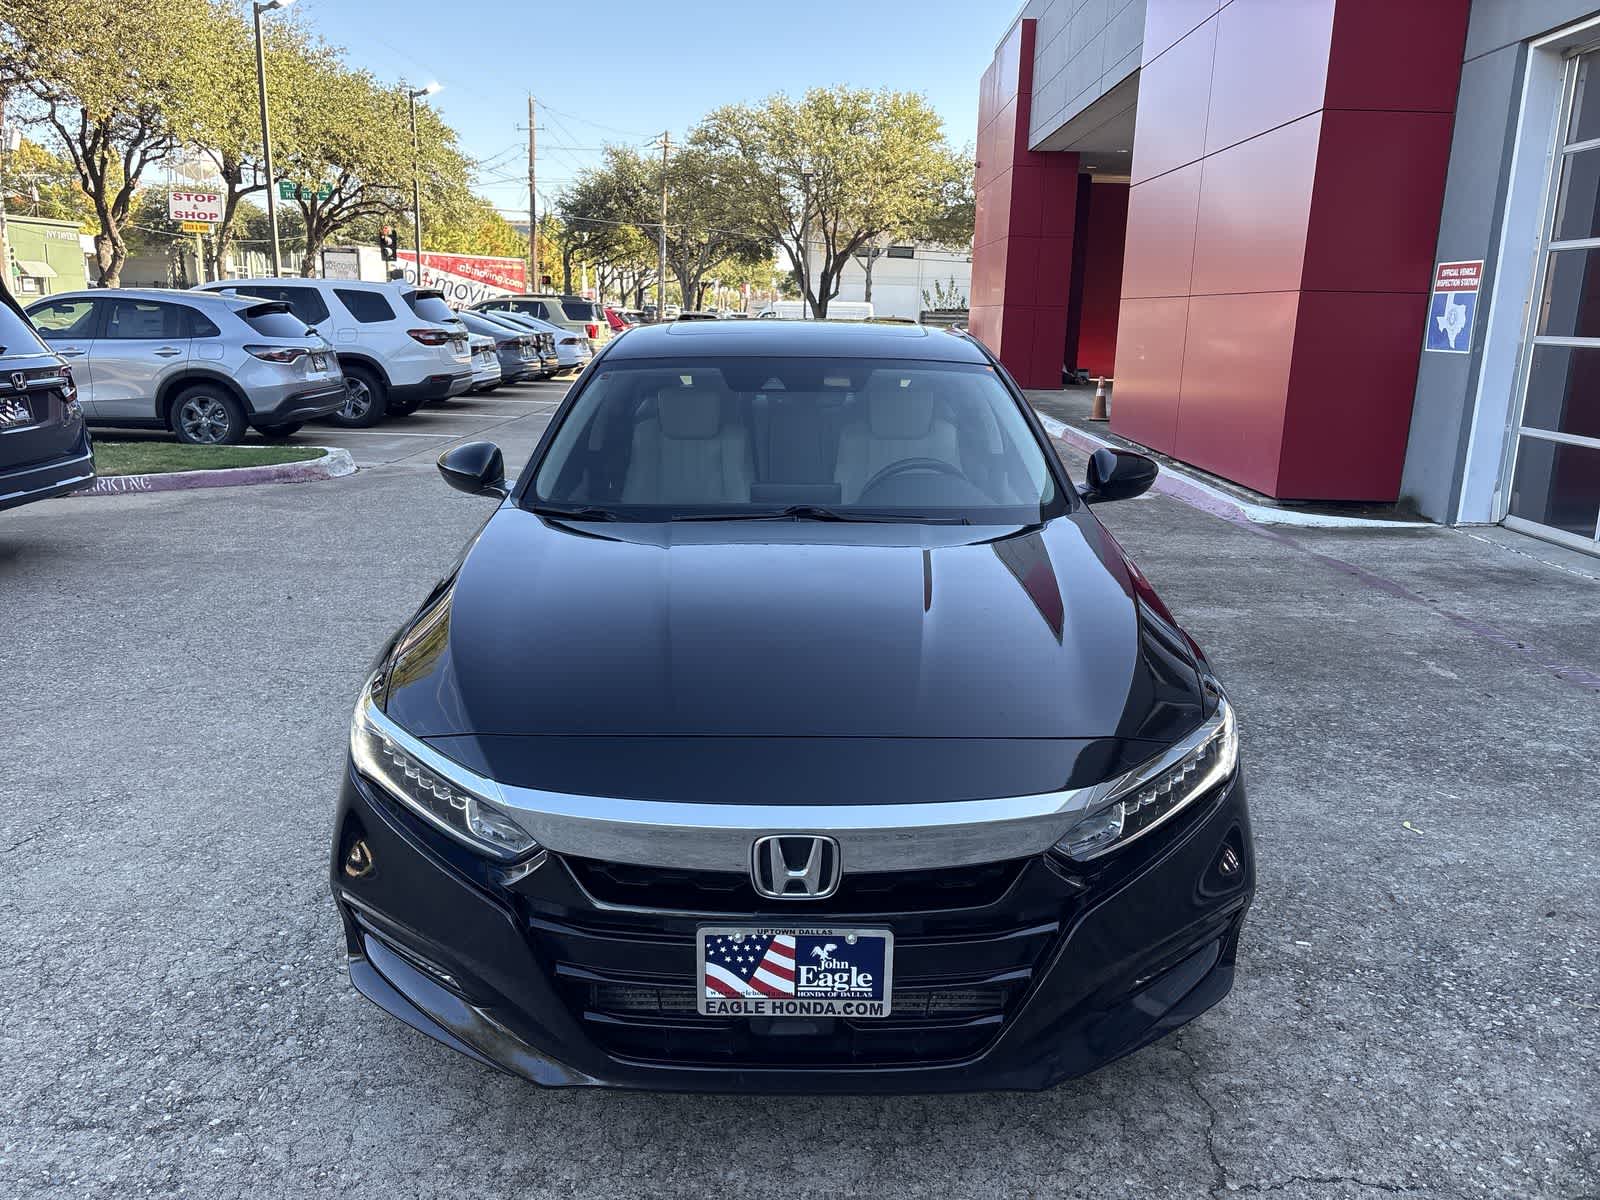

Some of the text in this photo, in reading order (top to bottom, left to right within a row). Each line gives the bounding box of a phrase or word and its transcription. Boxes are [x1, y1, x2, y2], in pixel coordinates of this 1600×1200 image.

[172, 193, 217, 203] STOP
[174, 210, 219, 220] SHOP
[459, 263, 523, 289] abmoving.com
[1441, 267, 1477, 277] OFFICIAL VEHICLE
[1437, 277, 1479, 287] INSPECTION STATION
[797, 965, 873, 992] Eagle
[706, 1001, 884, 1016] EAGLE HONDA.COM
